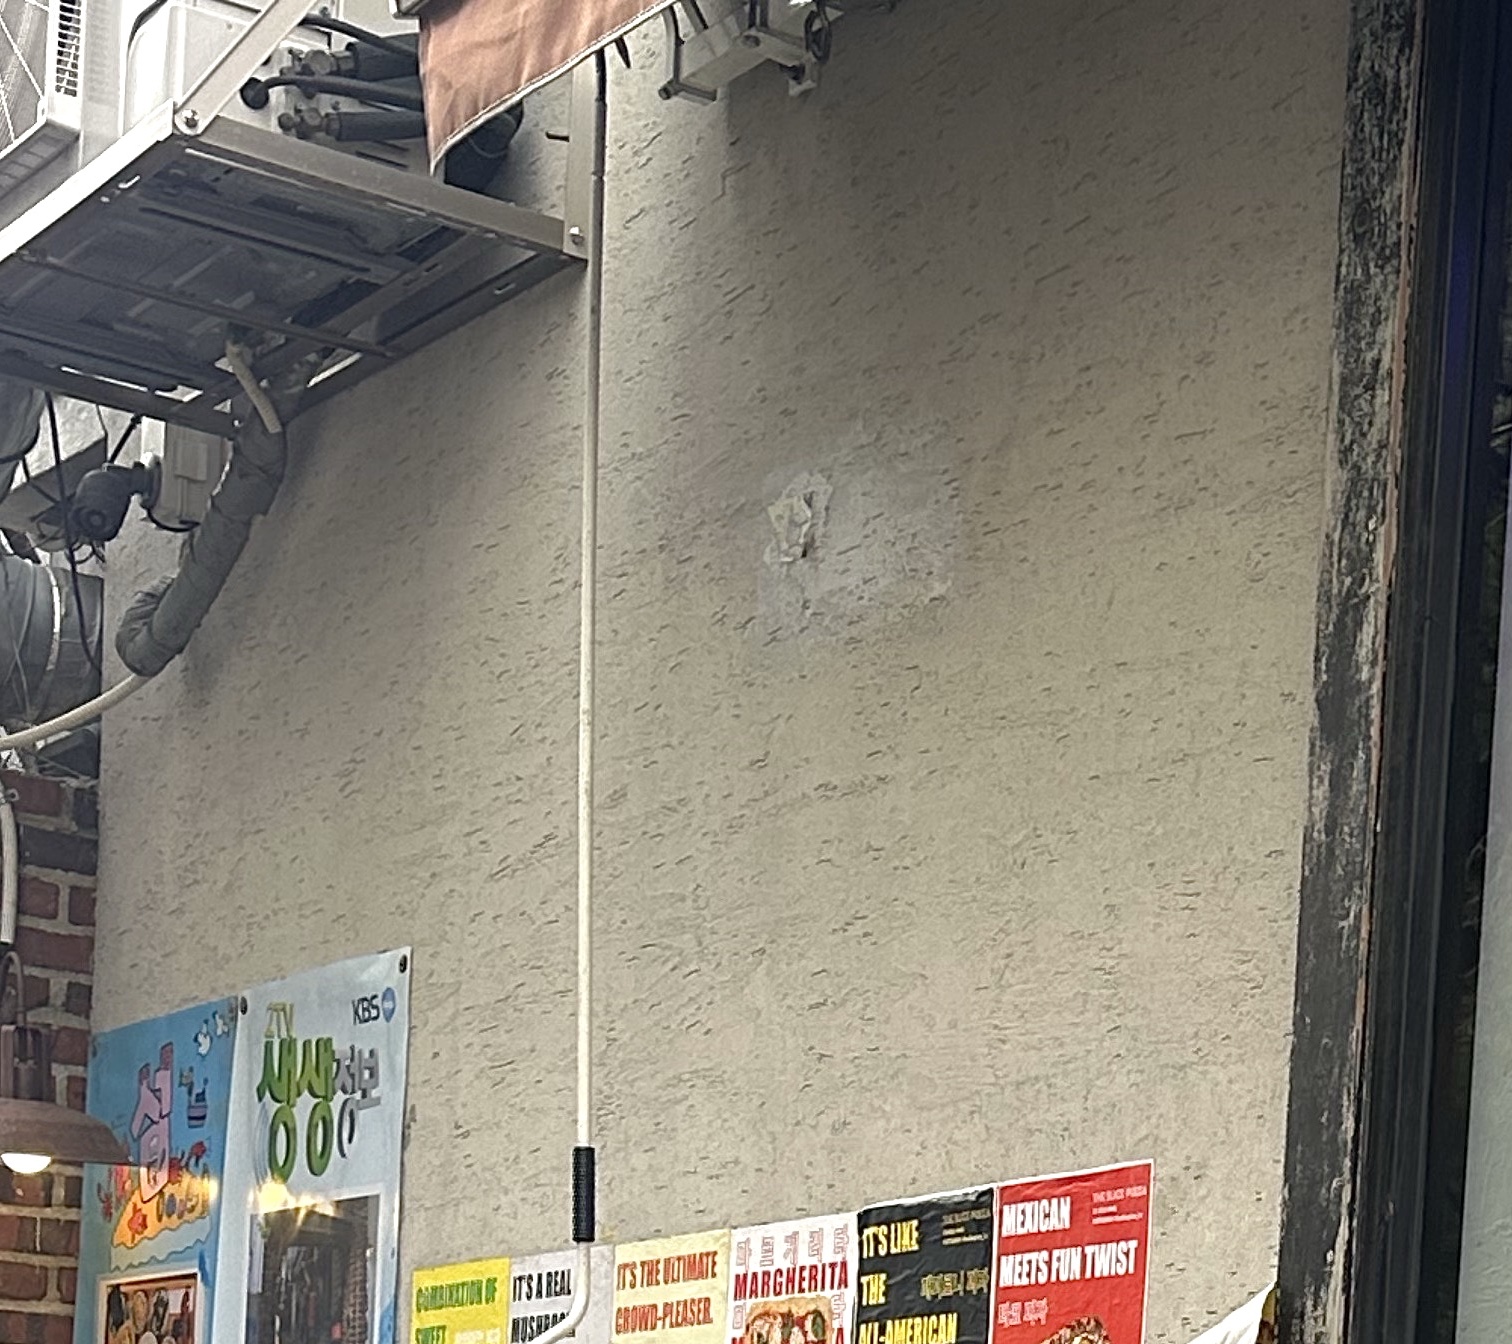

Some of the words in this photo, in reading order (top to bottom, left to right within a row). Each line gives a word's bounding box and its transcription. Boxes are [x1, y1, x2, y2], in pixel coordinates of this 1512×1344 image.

[352, 995, 380, 1025] KBS
[1002, 1197, 1070, 1238] MEXICAN
[862, 1225, 887, 1258] IT'S
[890, 1220, 919, 1252] LIKE
[639, 1260, 660, 1287] THE
[734, 1260, 848, 1301] MARGHERITA
[1000, 1251, 1049, 1288] MEETS
[1051, 1246, 1082, 1284] FUN
[1084, 1241, 1138, 1278] TWIST
[535, 1273, 544, 1299] A
[545, 1269, 571, 1298] REAL
[860, 1274, 886, 1306] THE
